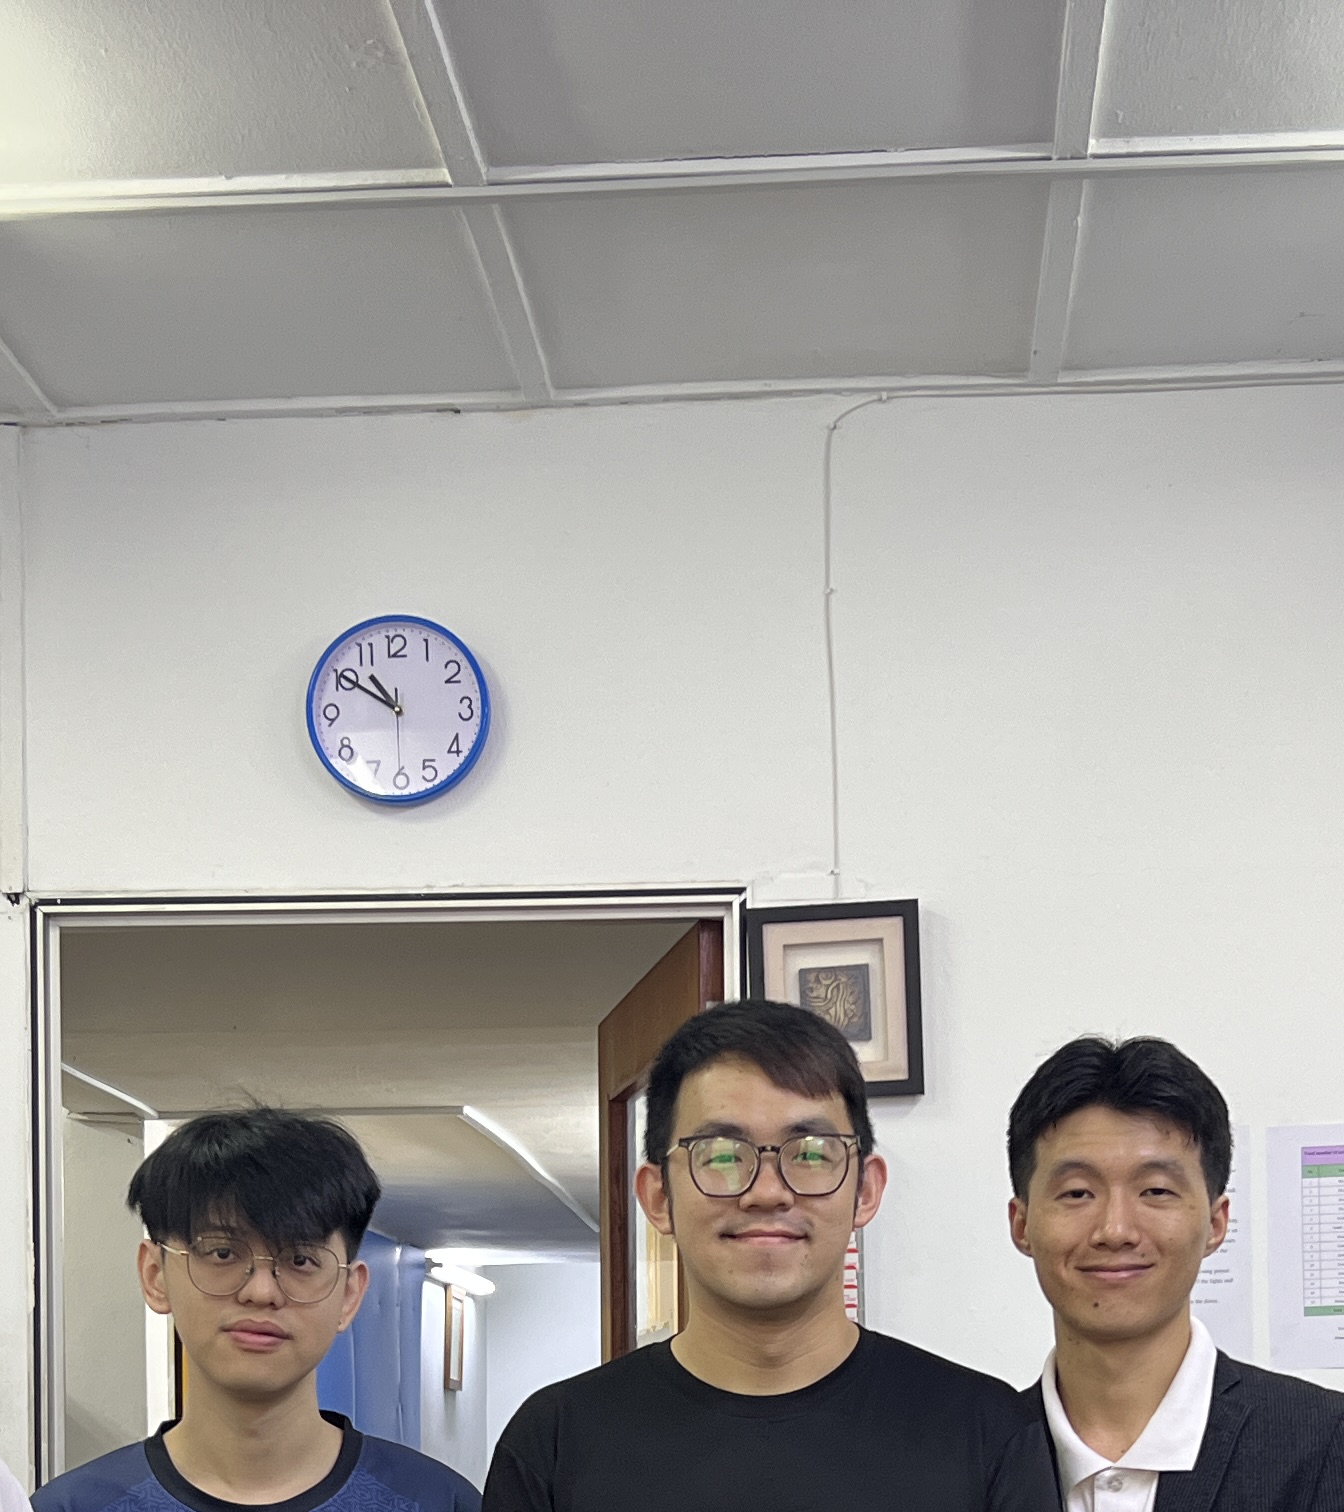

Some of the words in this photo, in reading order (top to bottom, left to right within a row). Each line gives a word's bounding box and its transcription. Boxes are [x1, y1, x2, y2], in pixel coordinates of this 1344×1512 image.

[356, 642, 374, 666] 11
[385, 634, 407, 658] 12
[423, 638, 430, 662] 1
[333, 668, 359, 692] 10
[444, 660, 461, 684] 2
[323, 703, 340, 728] 9
[458, 696, 474, 721] 3
[338, 736, 354, 761] 8
[447, 733, 462, 757] 4
[366, 760, 381, 778] 7
[392, 765, 410, 790] 6
[422, 759, 438, 783] 5
